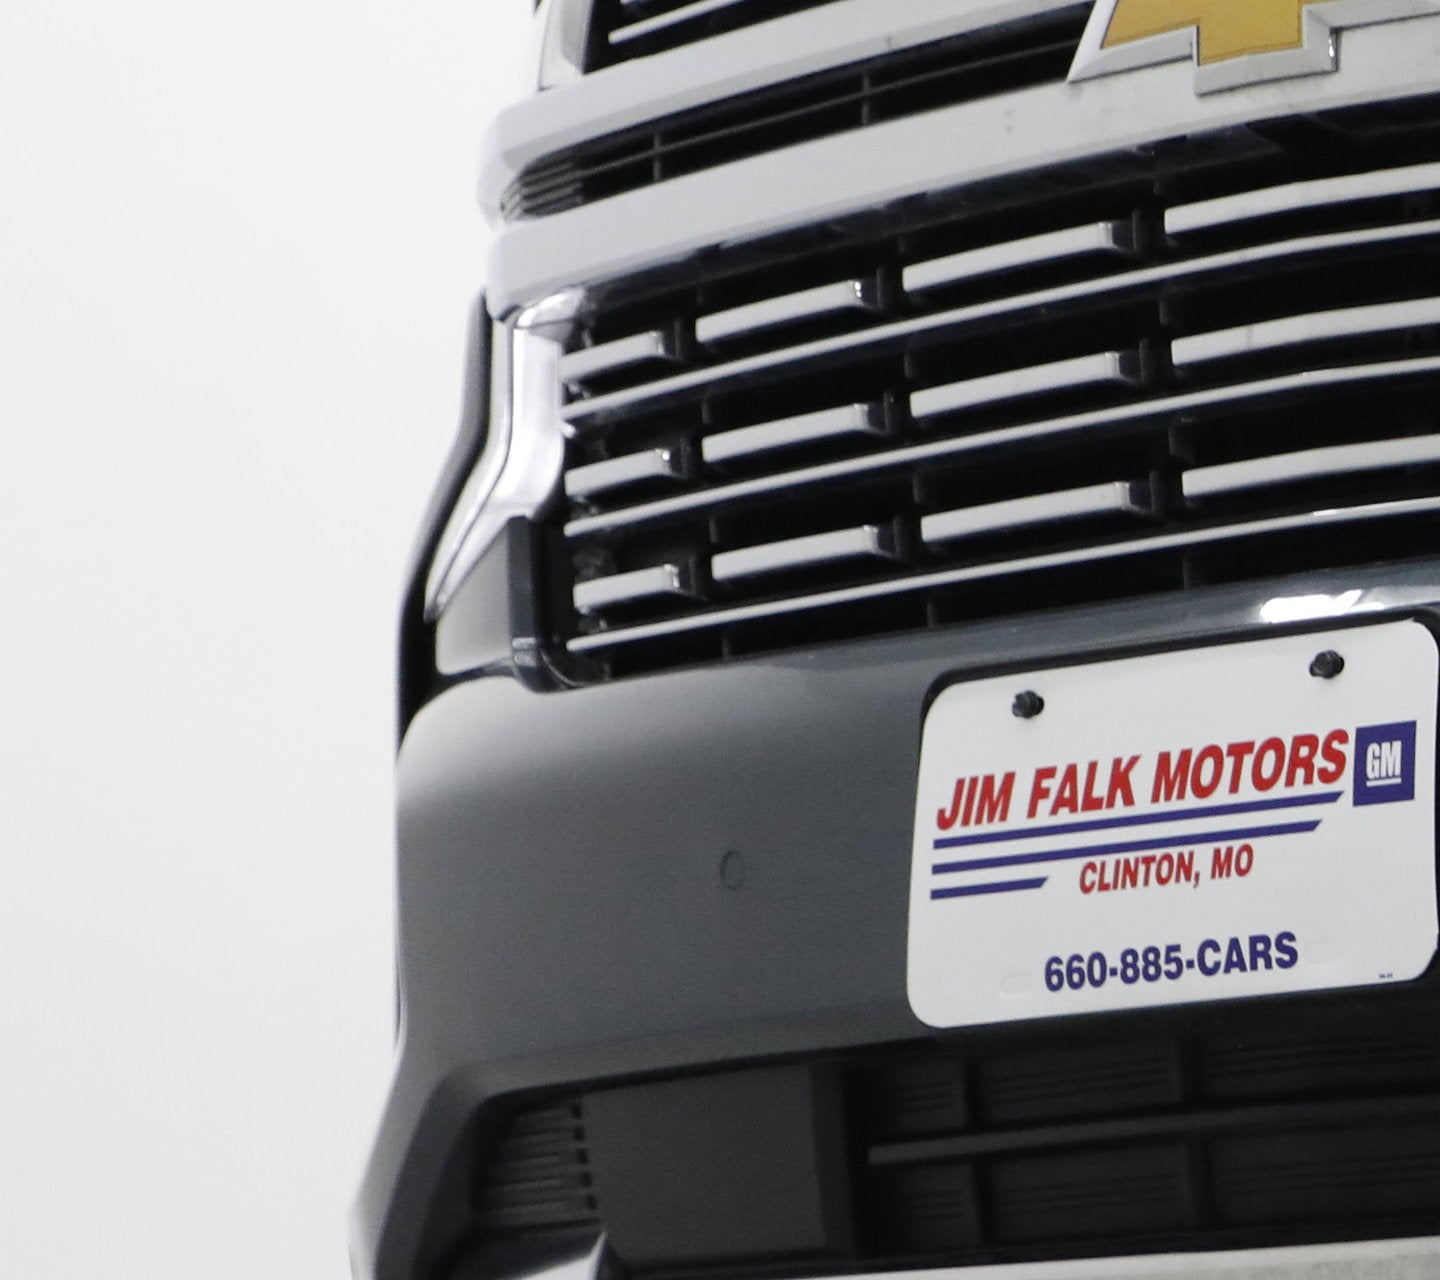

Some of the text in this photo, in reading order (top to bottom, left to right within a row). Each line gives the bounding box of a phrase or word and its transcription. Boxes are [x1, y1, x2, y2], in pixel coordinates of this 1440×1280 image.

[936, 728, 1350, 831] JIM FALK MOTORS
[1365, 740, 1402, 787] GM
[1079, 843, 1254, 894] CLINTON, MO
[1043, 931, 1299, 992] 660-885-CARS
